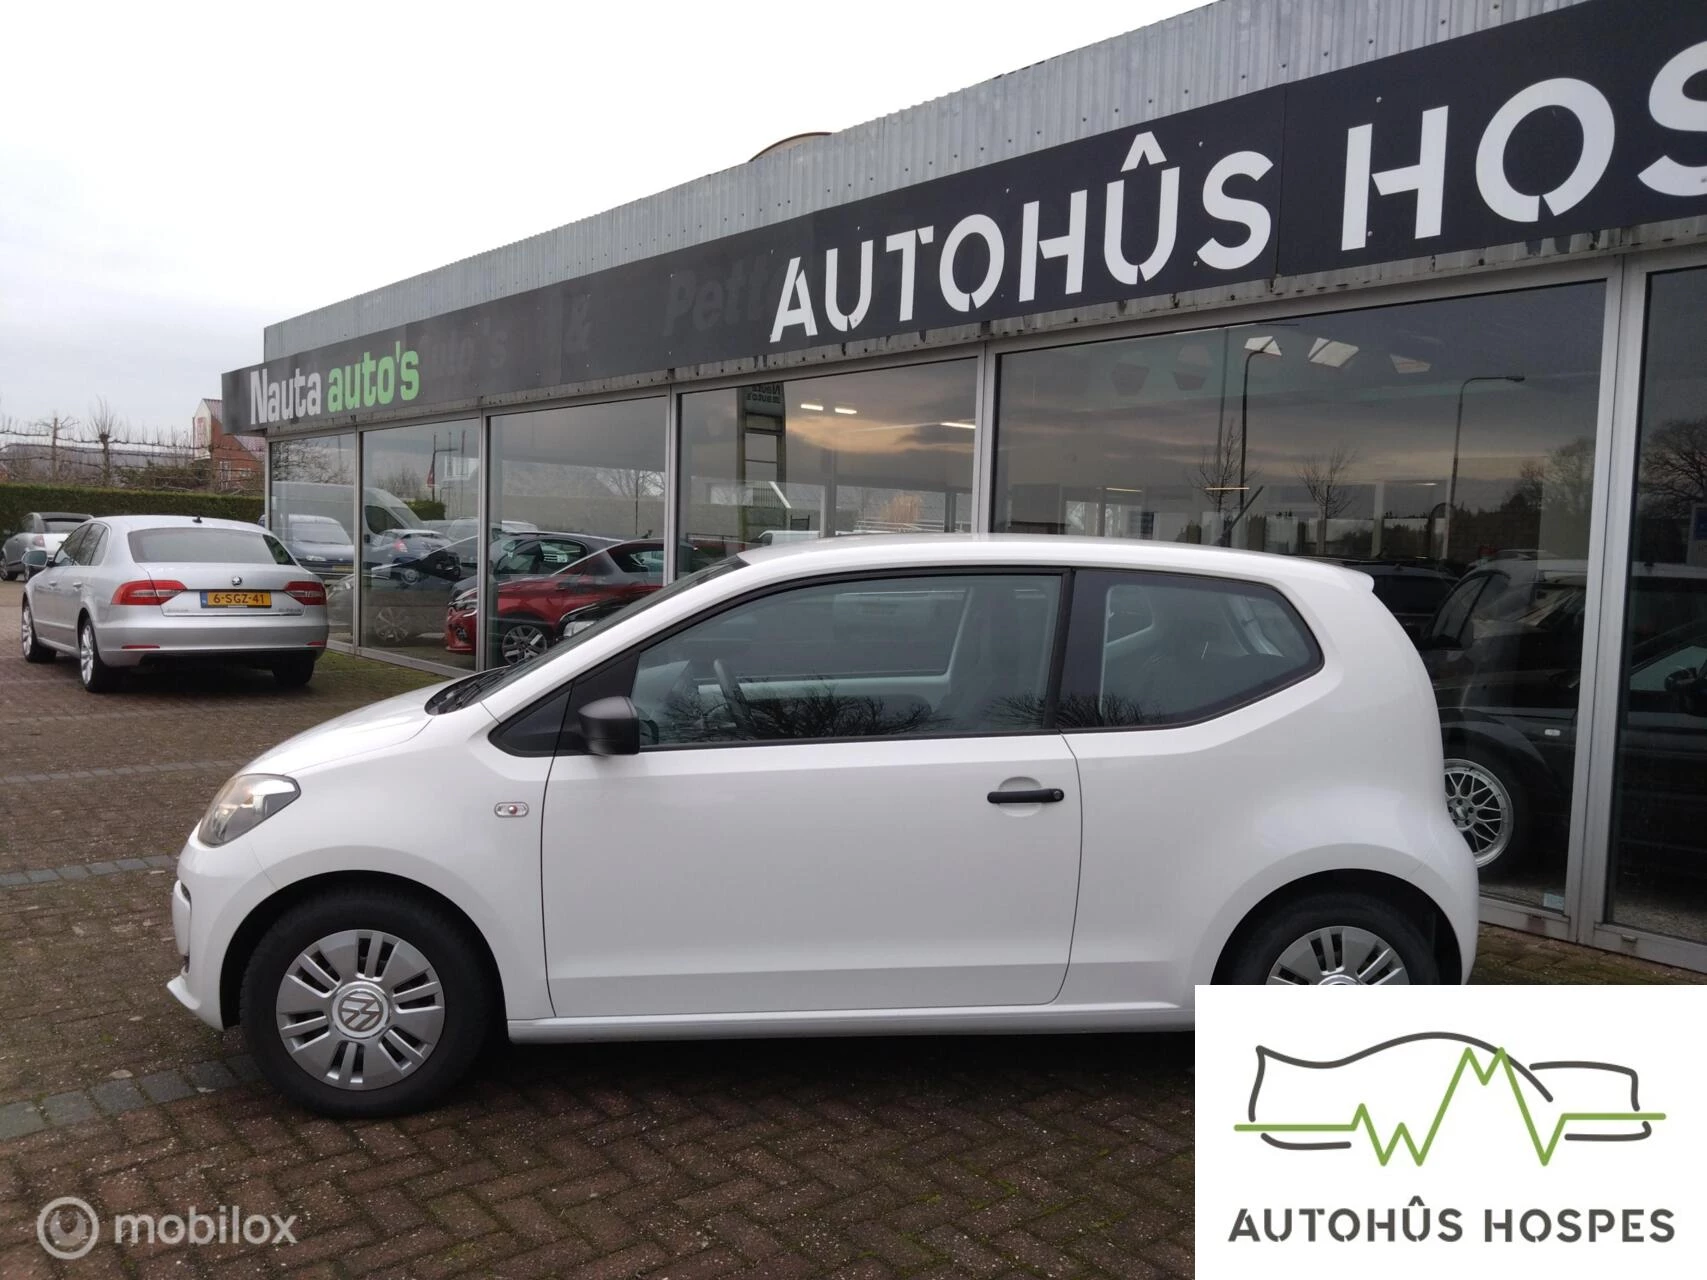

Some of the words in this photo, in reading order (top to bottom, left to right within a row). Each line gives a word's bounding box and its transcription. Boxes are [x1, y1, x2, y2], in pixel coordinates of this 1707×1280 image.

[769, 130, 1275, 343] AUTOHÛS
[250, 368, 322, 425] Nauta
[327, 340, 420, 412] auto's
[213, 593, 264, 605] 6-SGZ-41
